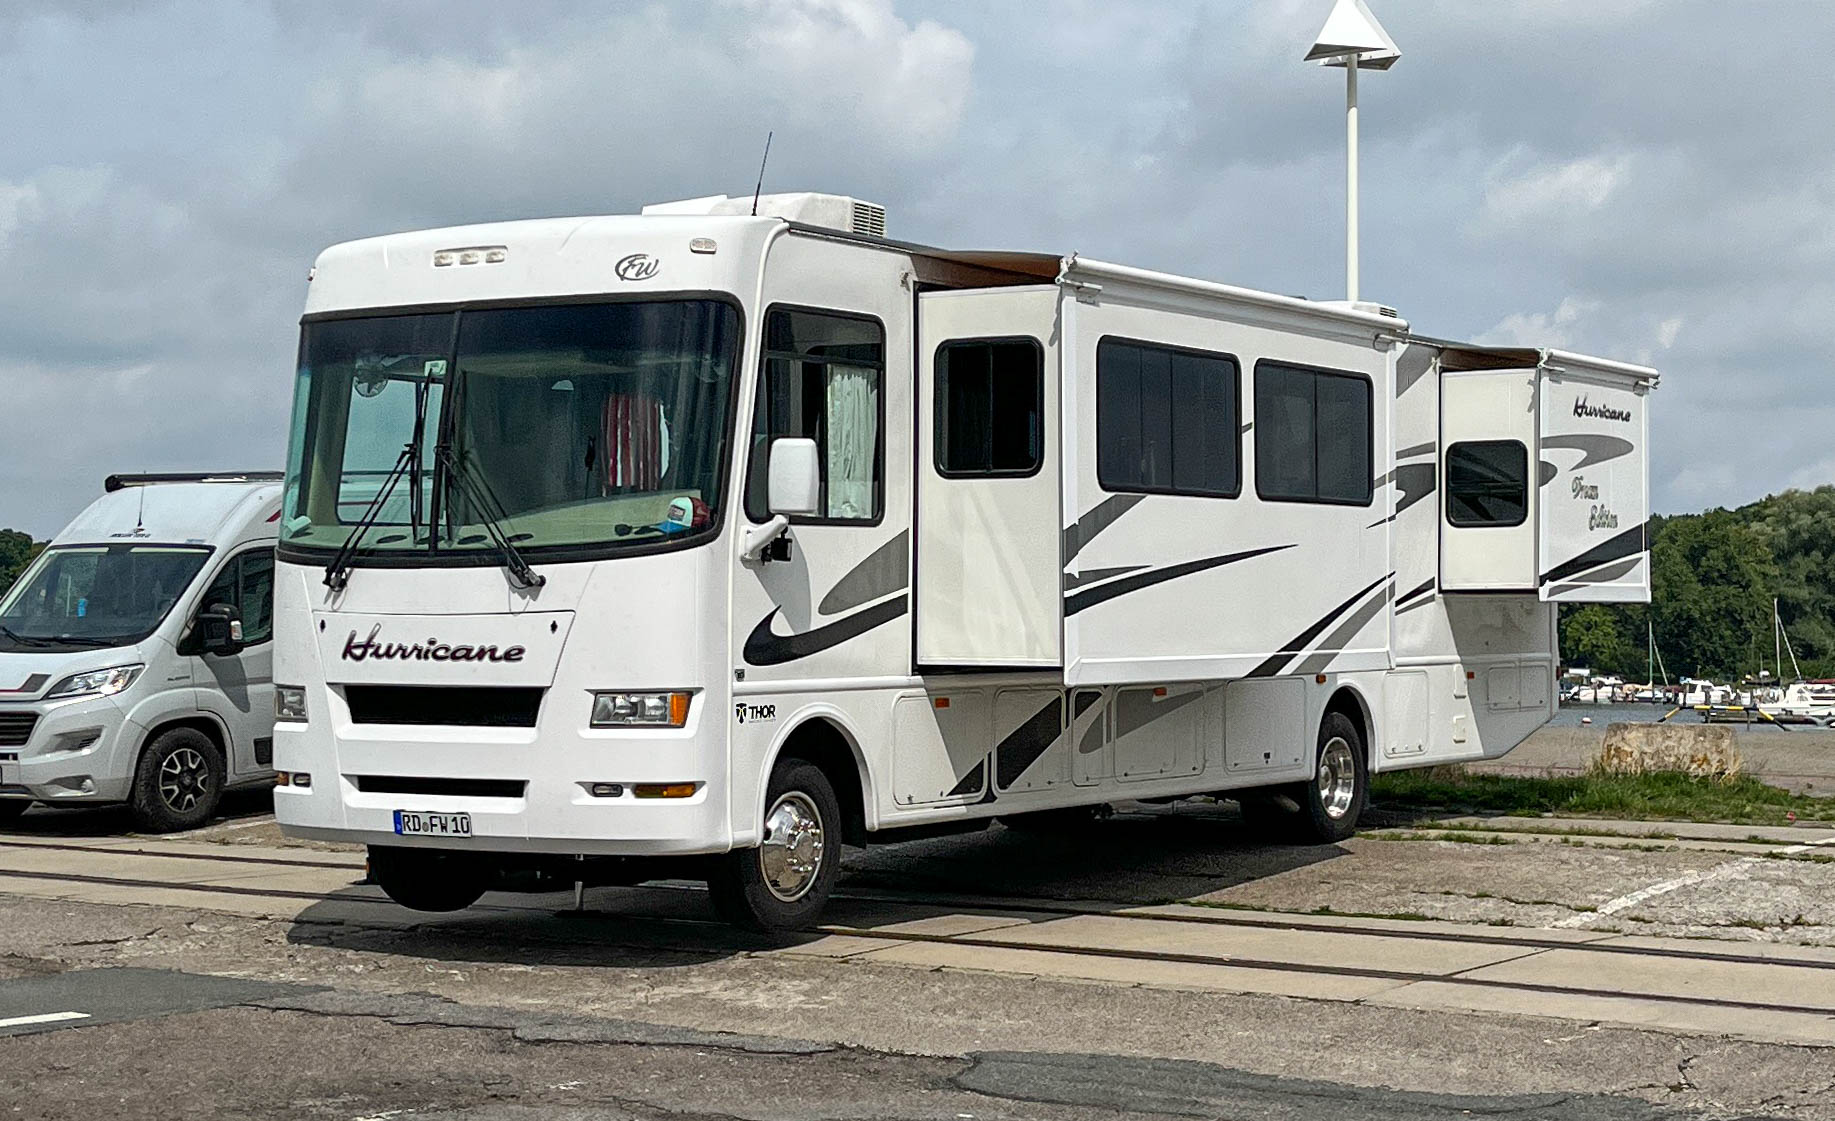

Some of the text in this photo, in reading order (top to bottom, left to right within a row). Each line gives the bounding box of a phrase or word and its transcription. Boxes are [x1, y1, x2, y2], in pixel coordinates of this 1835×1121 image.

[616, 254, 660, 280] FW
[1573, 393, 1631, 422] Hurricane
[342, 622, 526, 662] Hurricane
[748, 704, 776, 719] THOR
[402, 814, 470, 834] RD FW 10
